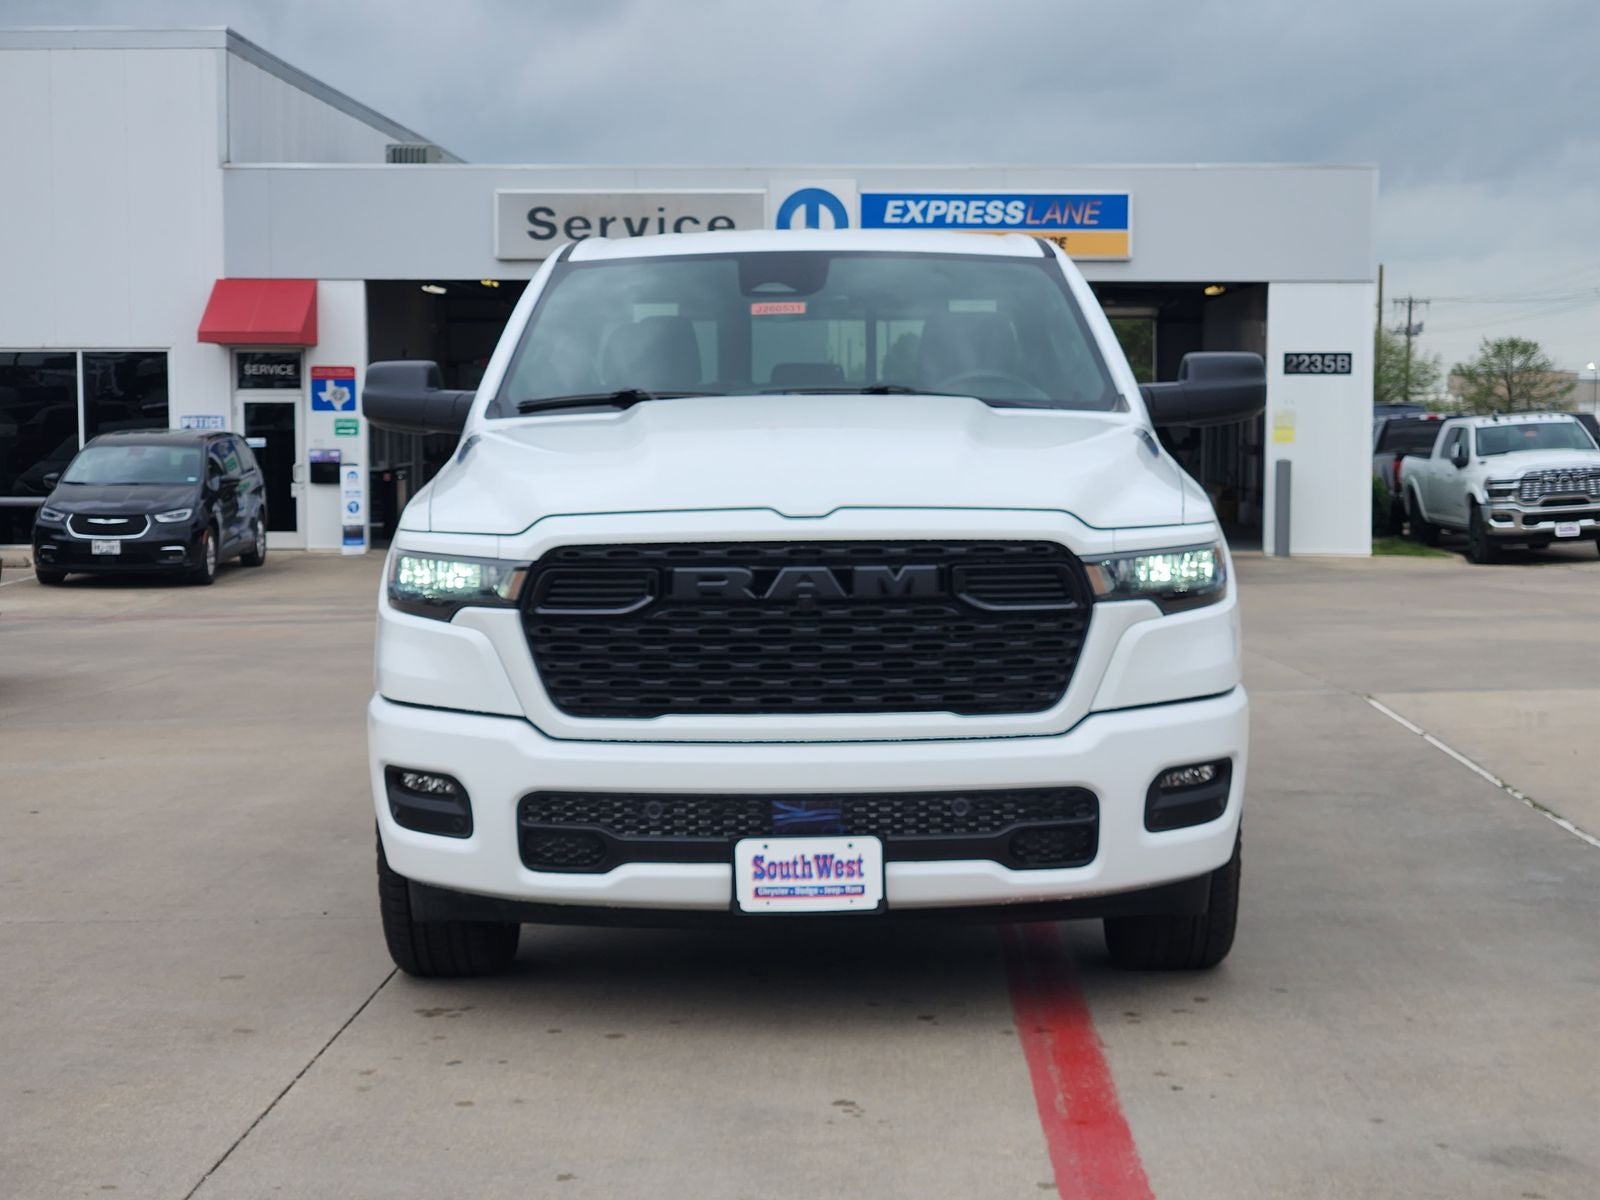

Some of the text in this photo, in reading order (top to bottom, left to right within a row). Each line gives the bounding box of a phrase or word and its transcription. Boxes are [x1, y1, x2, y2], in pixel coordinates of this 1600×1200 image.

[526, 205, 736, 242] Service
[243, 363, 295, 375] SERVICE
[1286, 354, 1350, 373] 2235B
[673, 565, 938, 598] RAM
[752, 853, 865, 880] SouthWest
[757, 887, 789, 897] Chrysler
[795, 887, 818, 896] Dodge
